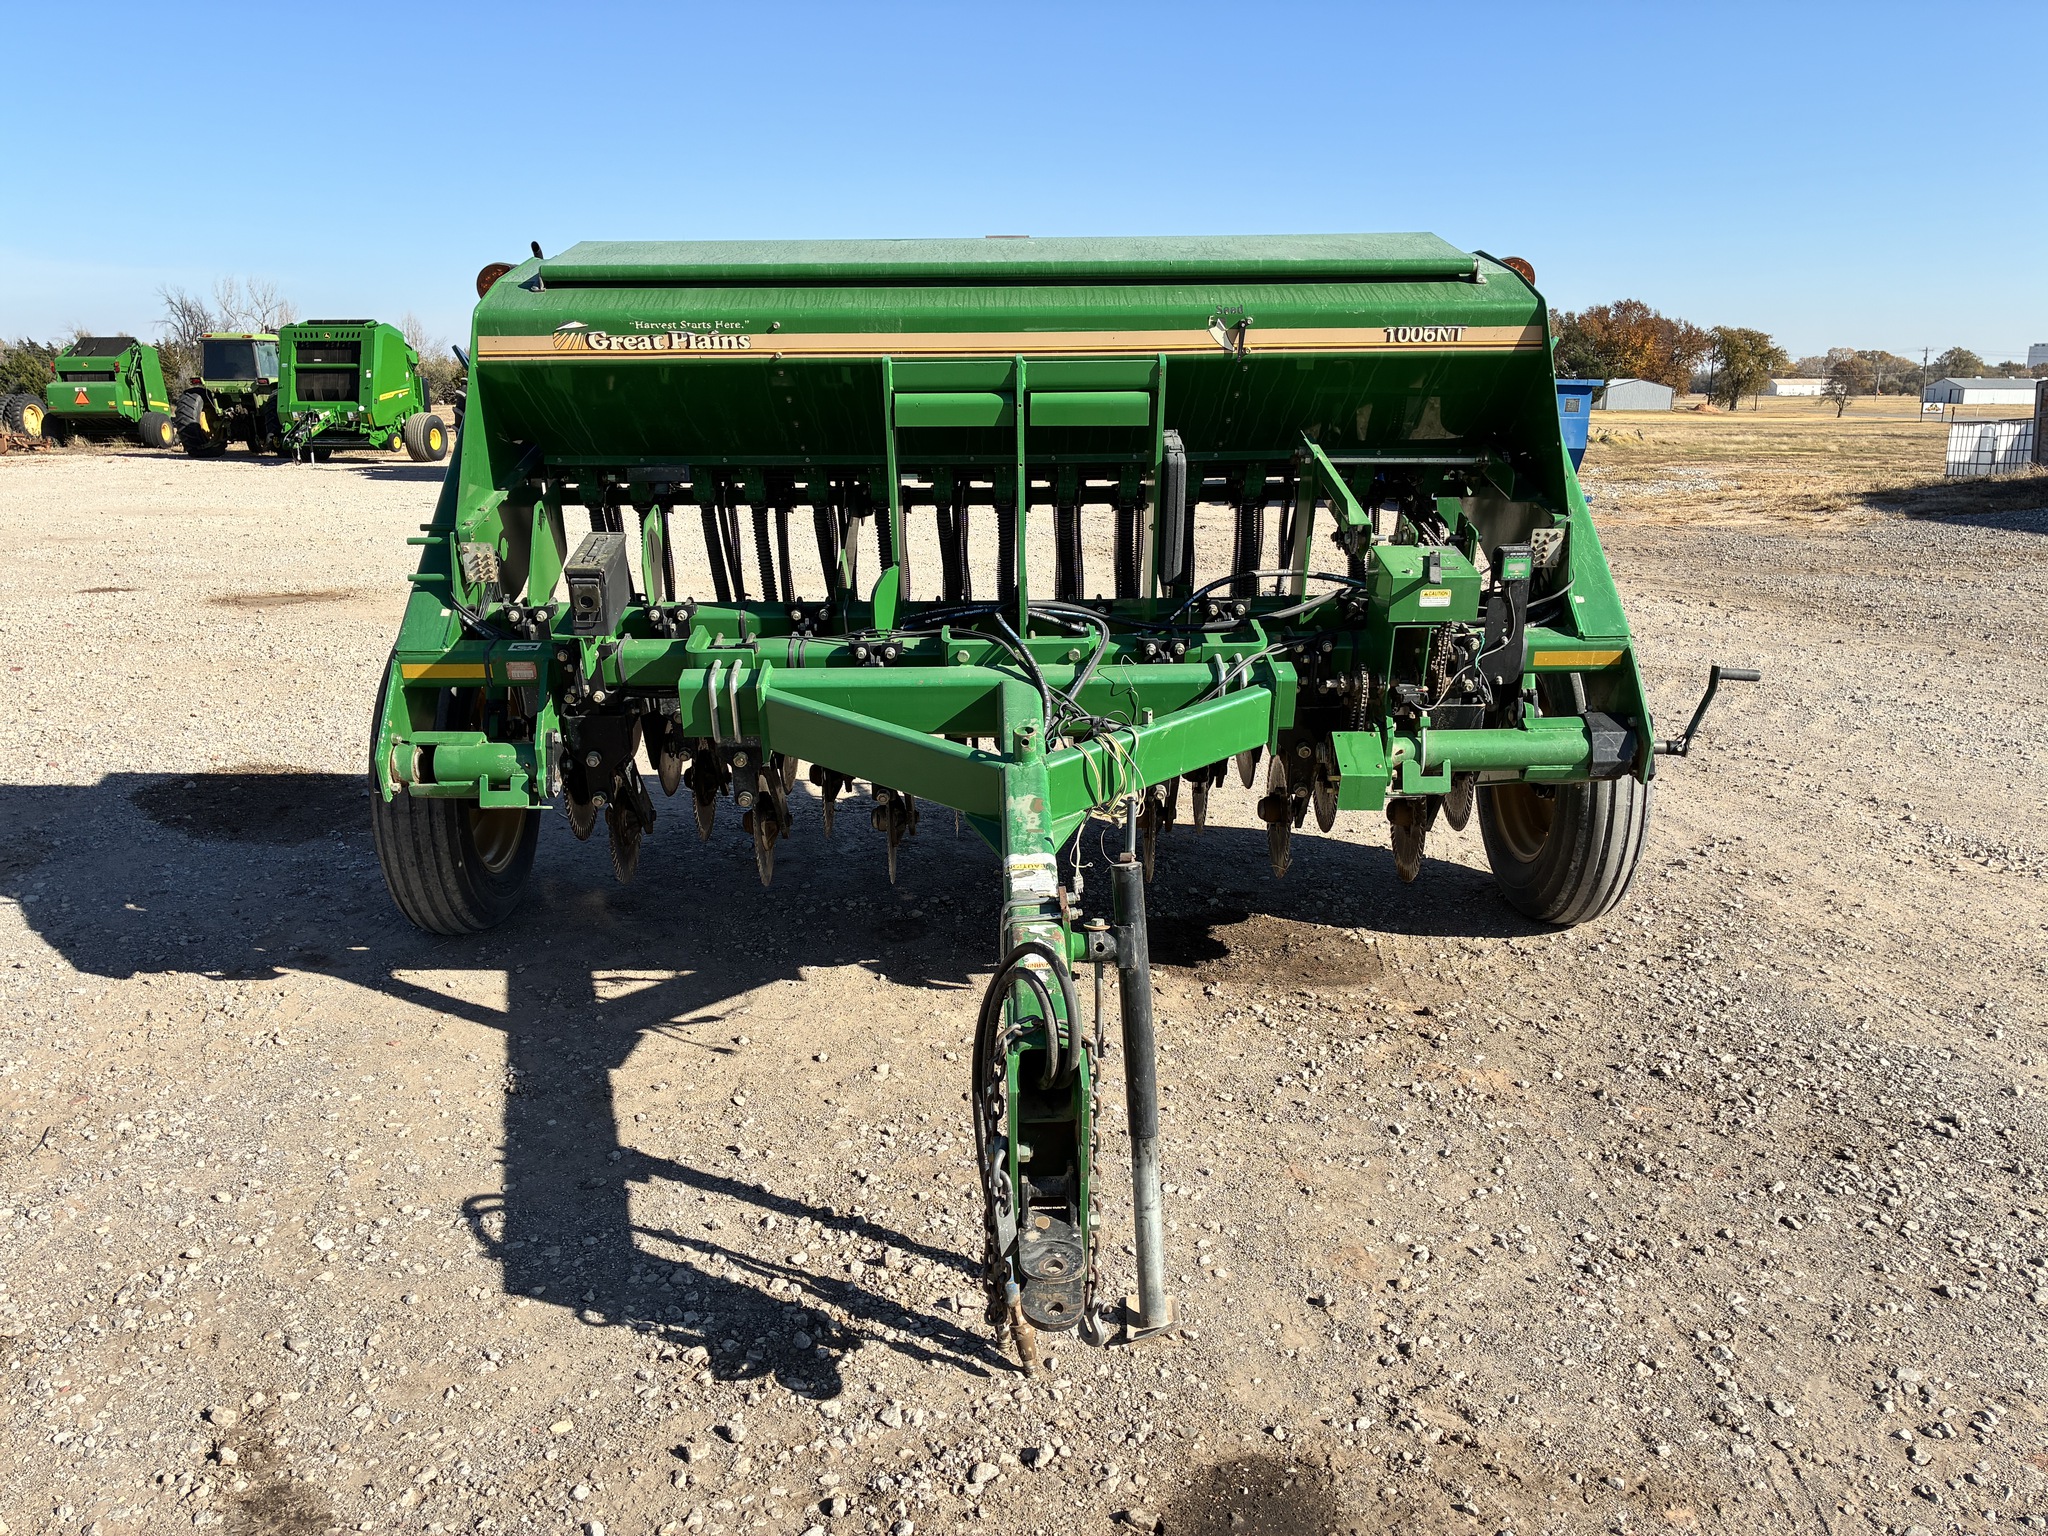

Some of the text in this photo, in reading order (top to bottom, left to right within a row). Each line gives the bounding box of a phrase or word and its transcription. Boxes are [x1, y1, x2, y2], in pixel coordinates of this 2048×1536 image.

[1216, 304, 1244, 315] Seed
[680, 320, 712, 330] Starts
[586, 330, 751, 350] Great Plains
[1384, 324, 1468, 343] 1006NT
